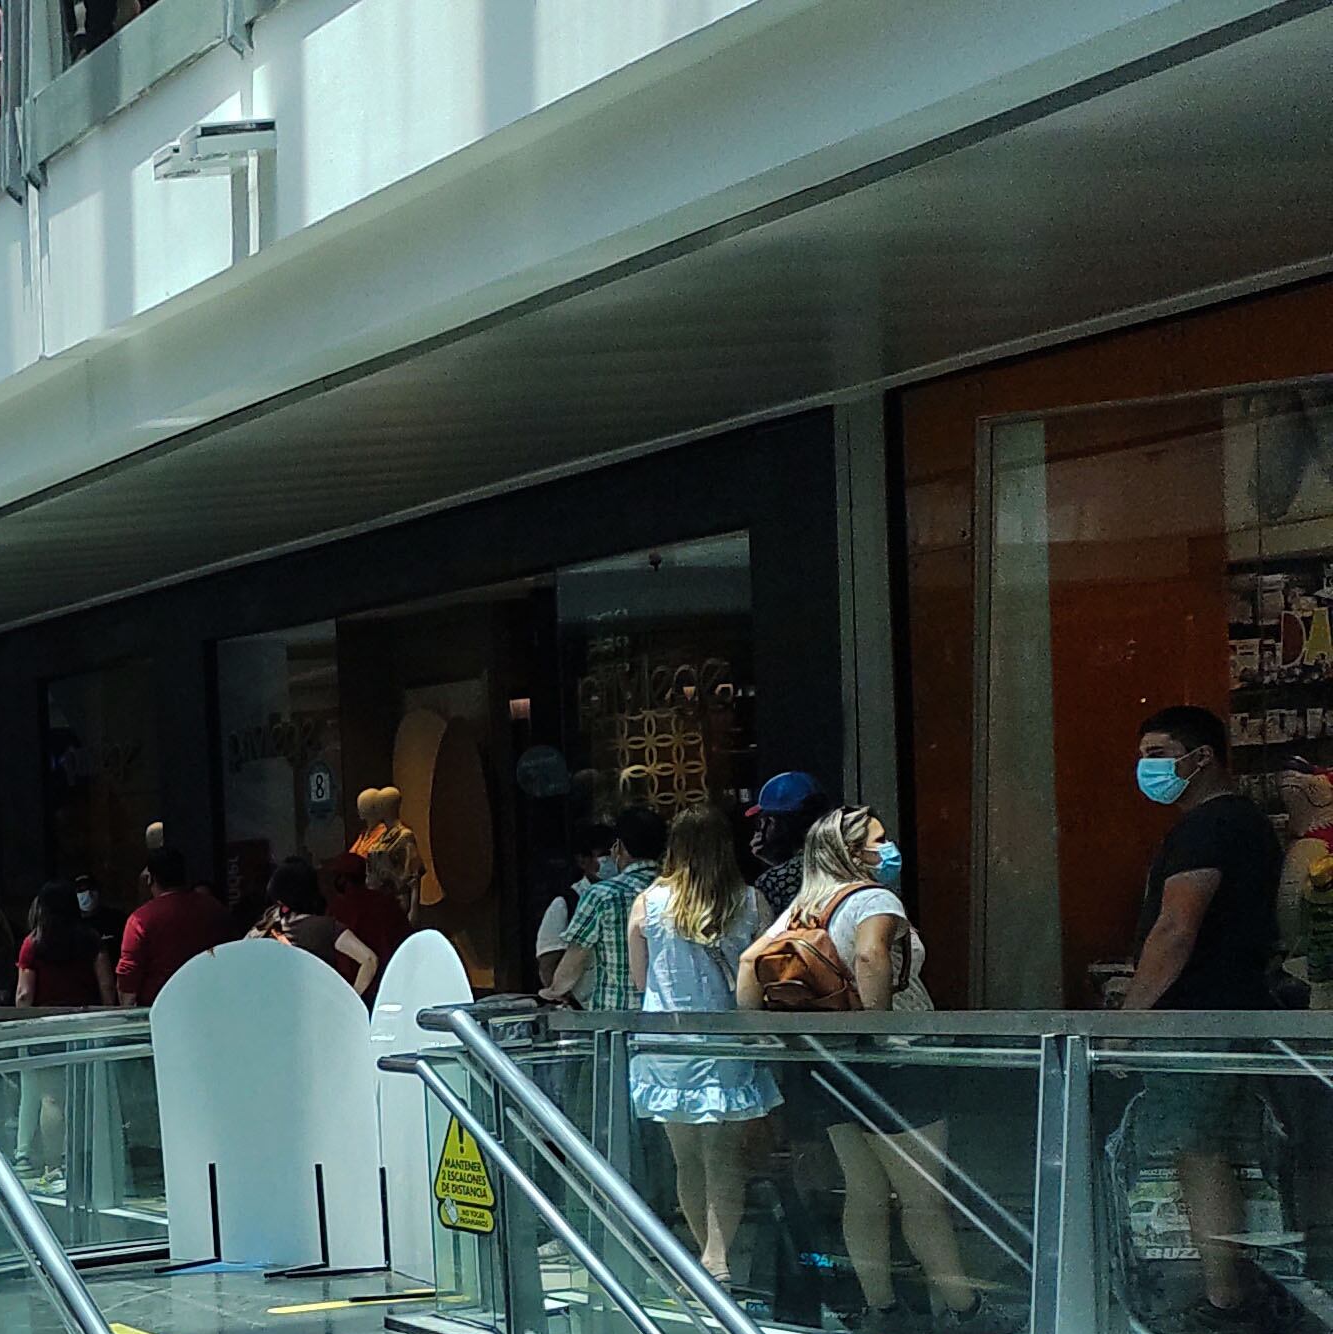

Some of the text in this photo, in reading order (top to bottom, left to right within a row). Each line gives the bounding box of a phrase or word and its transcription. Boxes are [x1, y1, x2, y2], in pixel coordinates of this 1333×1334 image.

[444, 1158, 482, 1172] MANTENER
[448, 1171, 486, 1186] ESCALONES
[441, 1182, 488, 1198] DE DISTANCIA
